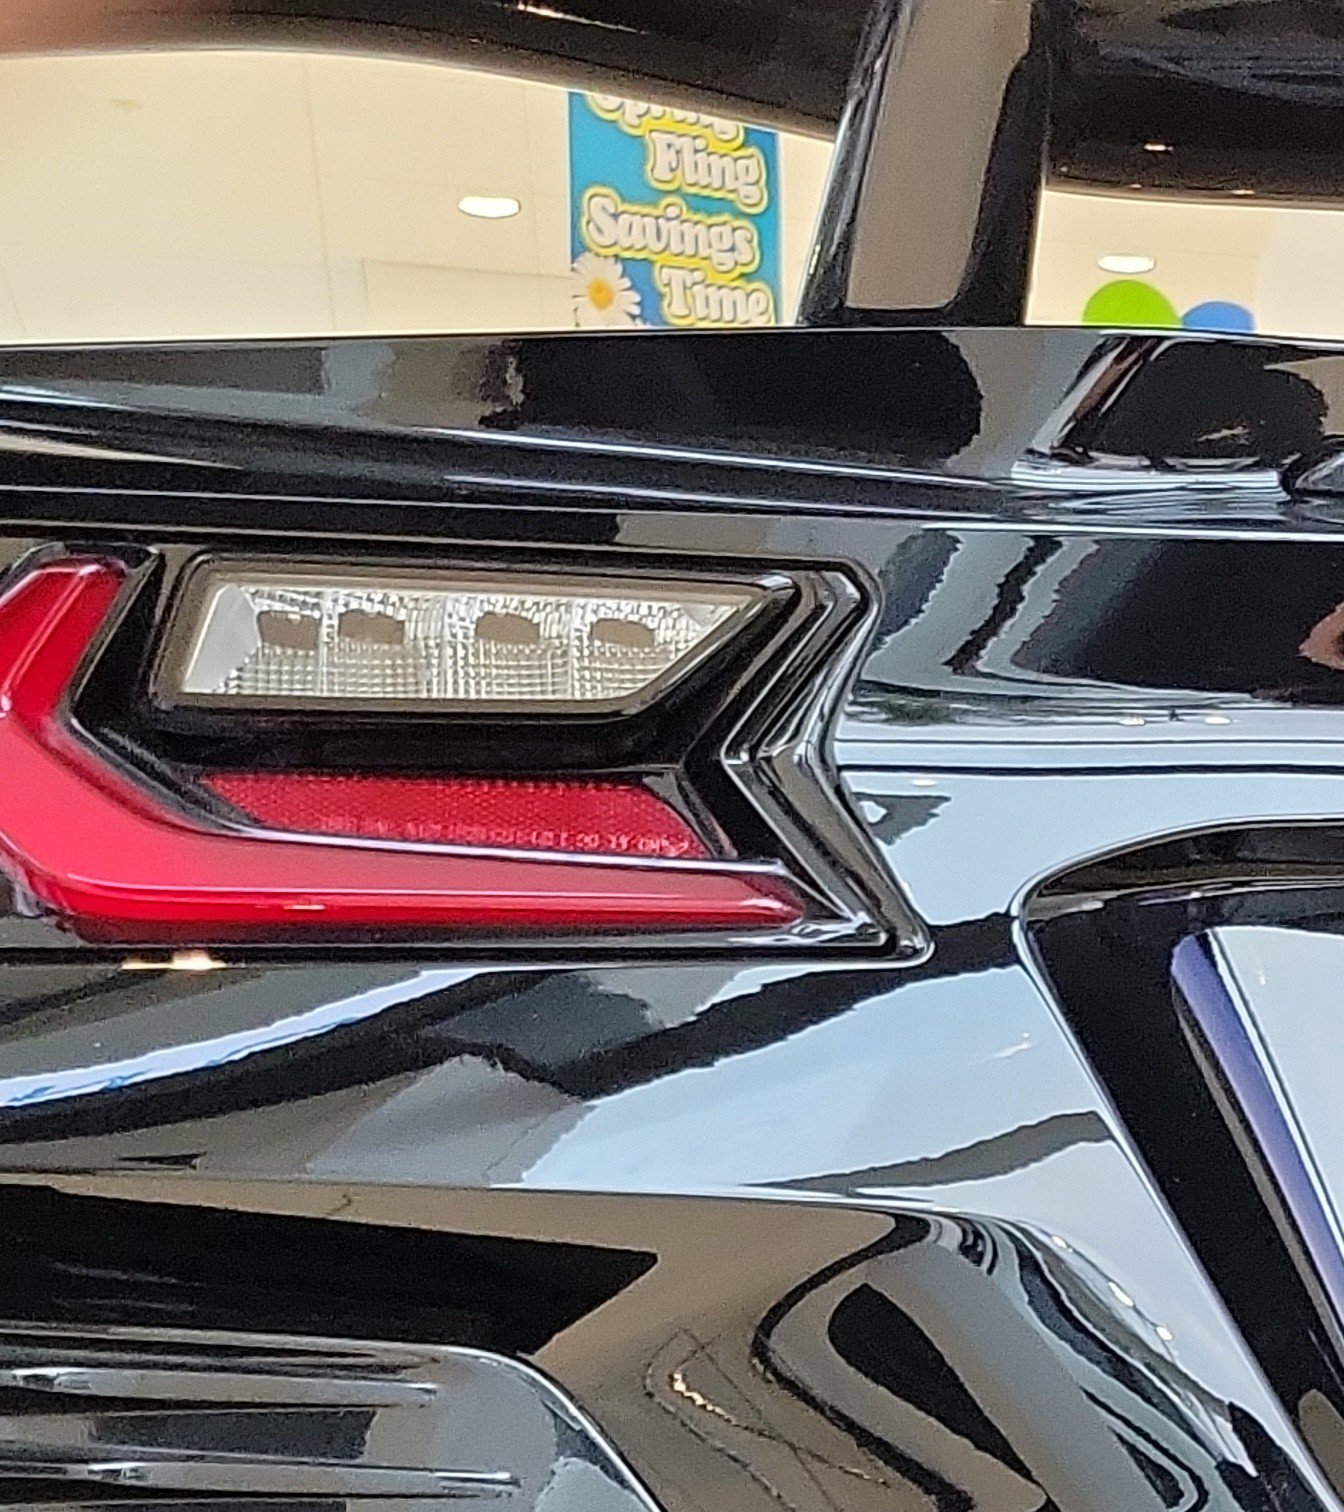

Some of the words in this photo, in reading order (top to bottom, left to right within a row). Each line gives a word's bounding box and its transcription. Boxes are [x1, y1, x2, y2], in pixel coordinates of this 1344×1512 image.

[650, 131, 762, 206] Fling
[586, 193, 756, 272] Savings
[659, 265, 771, 325] Time
